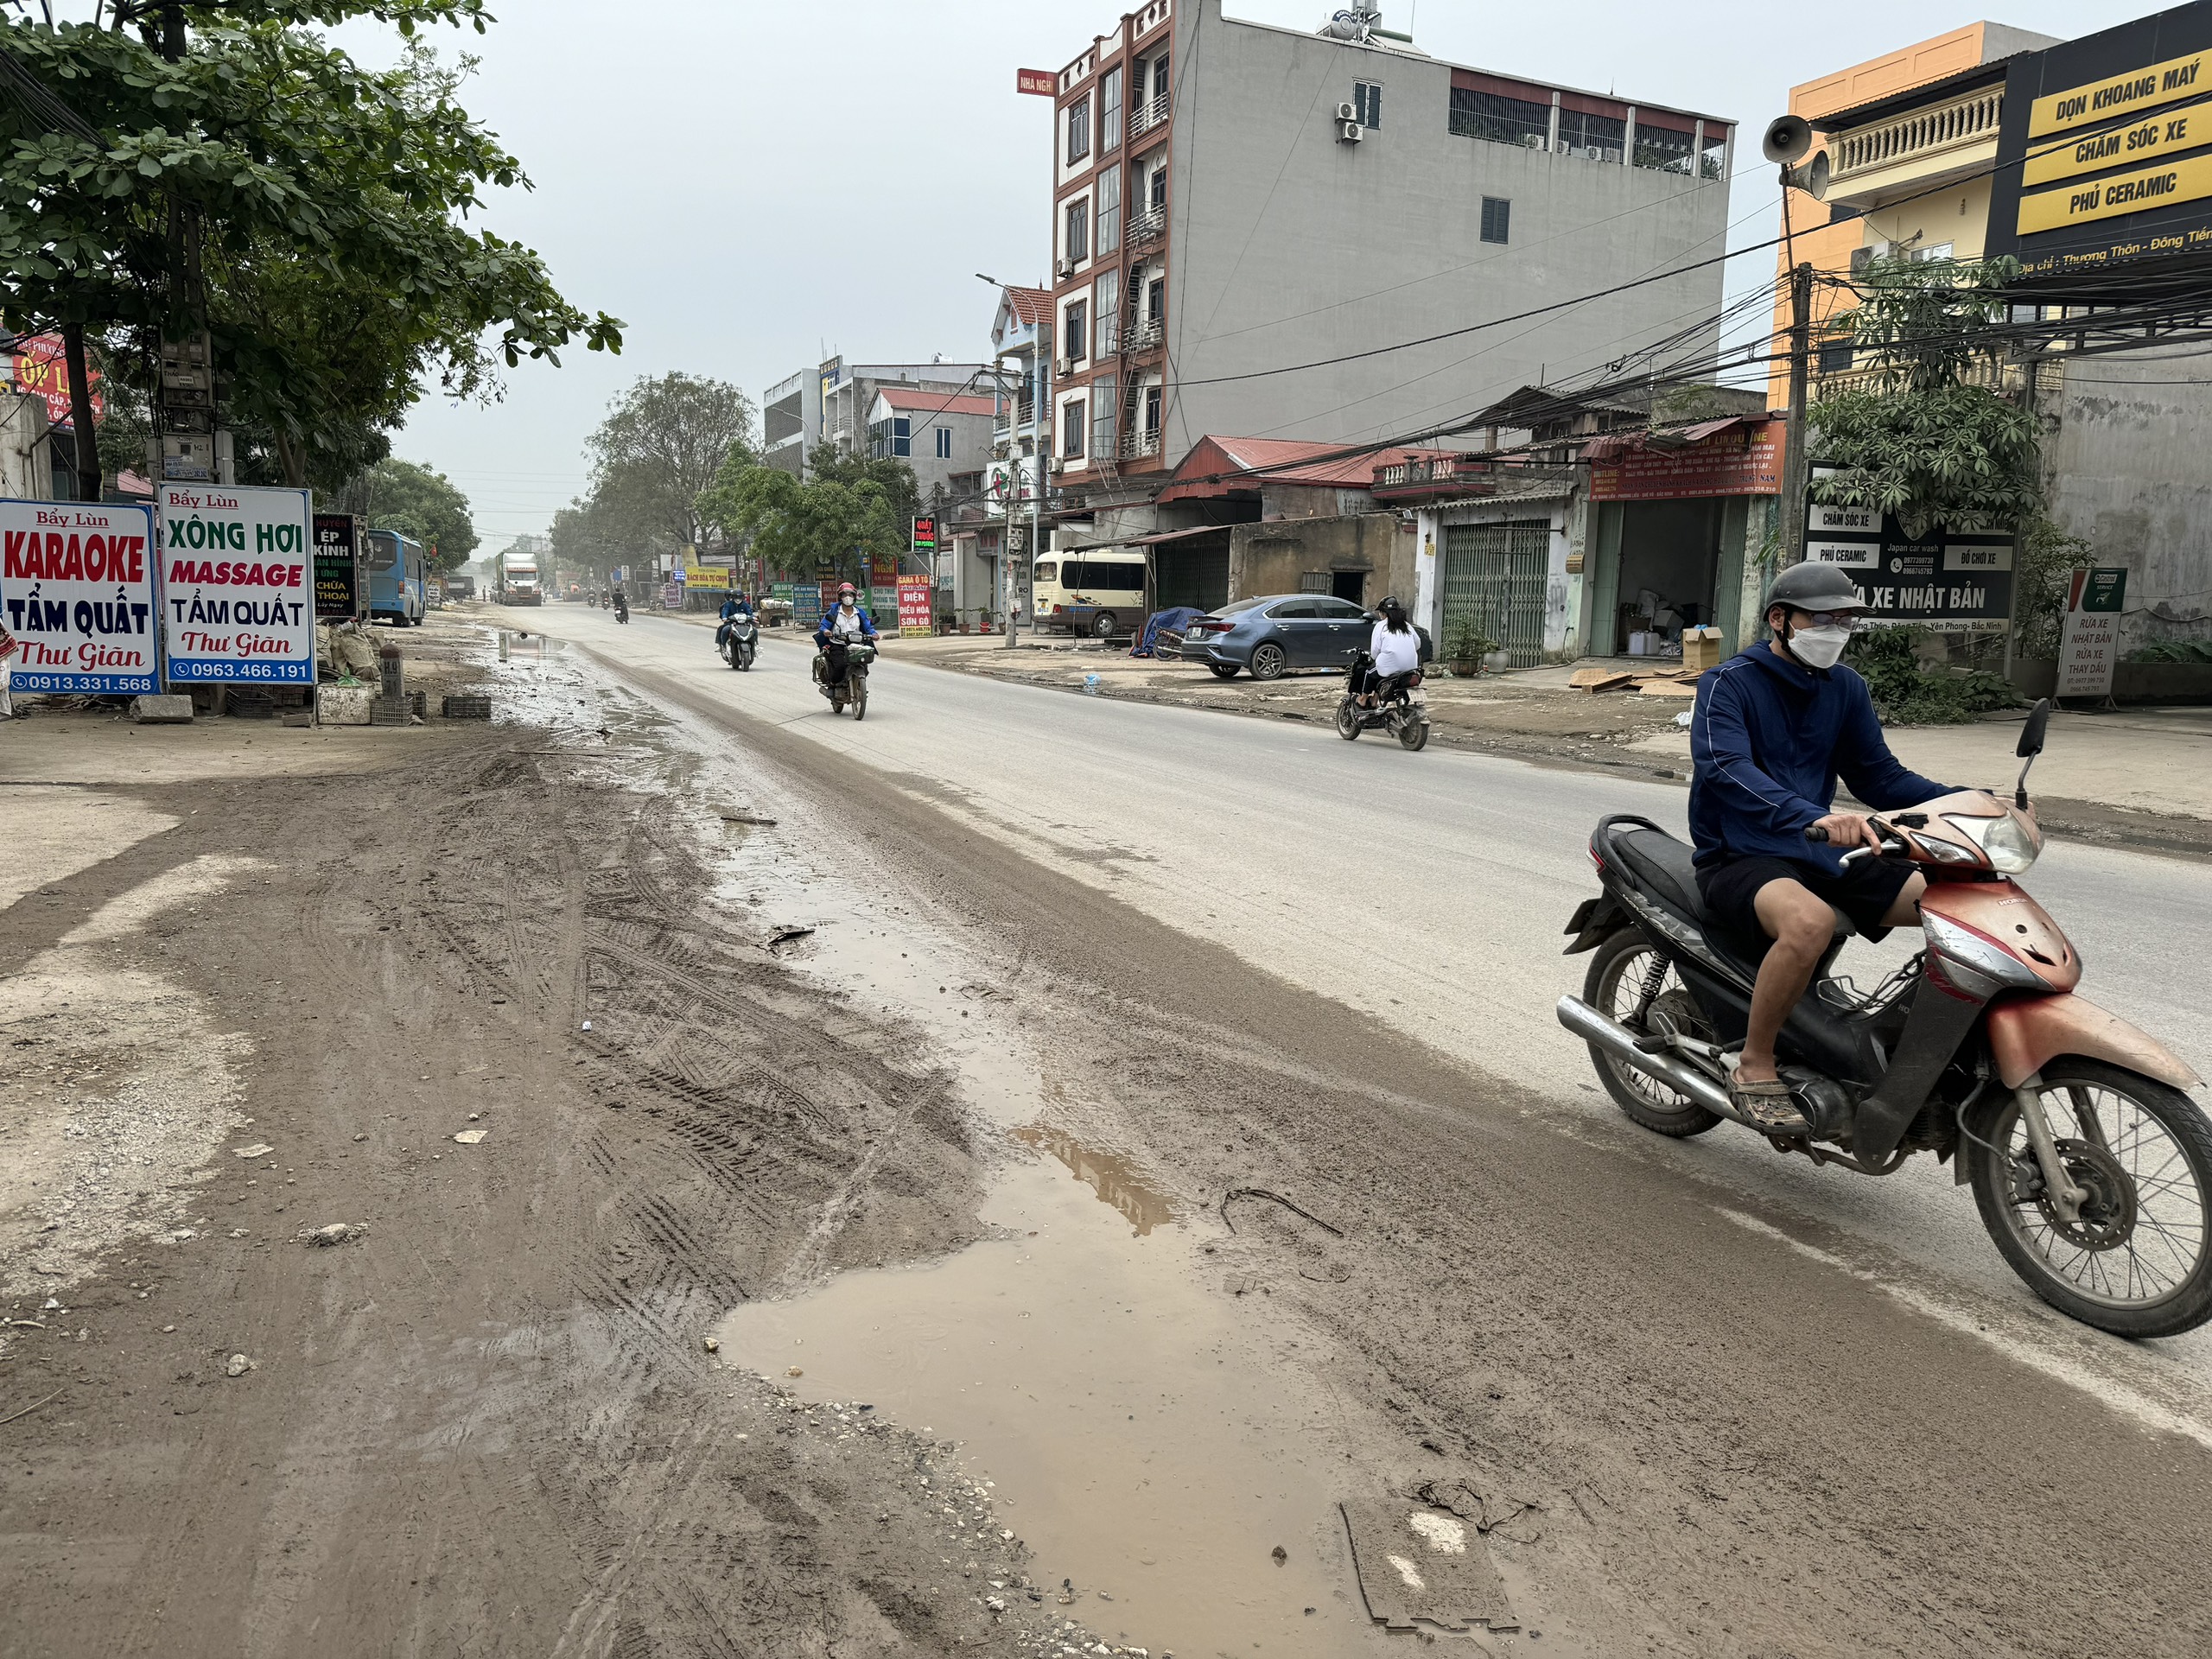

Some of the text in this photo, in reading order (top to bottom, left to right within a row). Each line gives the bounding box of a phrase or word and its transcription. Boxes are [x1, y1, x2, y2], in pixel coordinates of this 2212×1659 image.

[1020, 75, 1035, 90] NHÀ
[2056, 93, 2087, 122] DỌN
[2092, 75, 2156, 111] KHOANG
[2075, 118, 2188, 164] CHĂM SÓC XE
[2069, 173, 2177, 215] PHỦ CERAMIC
[2063, 250, 2107, 265] Thượng
[2110, 244, 2140, 257] Thôn
[2151, 237, 2183, 251] Đông
[2187, 226, 2212, 244] Tiến
[1759, 474, 1776, 483] NAM
[168, 489, 238, 509] Bẩy Lùn
[36, 508, 109, 527] Bẩy Lùn
[1823, 512, 1870, 526] CHĂM SÓC XE
[168, 513, 302, 555] XÔNG HƠI
[320, 529, 340, 543] ÉP
[313, 543, 348, 556] KÍNH
[1820, 545, 1866, 563] PHỦ CERAMIC
[1888, 543, 1908, 554] Japan
[1922, 544, 1939, 553] wash
[4, 531, 144, 582] KARAOKE
[314, 557, 328, 567] ÀN
[1972, 551, 1986, 564] CHƠI
[1987, 553, 1996, 564] XE
[168, 560, 304, 588] MASSAGE
[316, 581, 346, 590] CHỮA
[317, 592, 349, 602] THOẠI
[904, 592, 925, 603] ĐIỆN
[1872, 587, 1894, 608] XE
[1899, 583, 1945, 613] NHẬT
[1949, 581, 1986, 609] BẢN
[7, 582, 149, 639] TẨM QUẤT
[170, 588, 304, 626] TẨM QUẤT
[901, 617, 917, 626] SƠN
[1930, 621, 1943, 630] Yên
[1971, 620, 1985, 630] Bắc
[1986, 621, 2002, 630] Ninh
[2079, 616, 2108, 629] RỬA XE
[181, 631, 293, 658] Thư Giãn
[2071, 631, 2113, 646] NHẬT BẢN
[16, 641, 145, 671] Thư Giãn
[2075, 647, 2103, 659] RỬA XE
[192, 663, 306, 678] 0963.466.191
[2069, 664, 2089, 674] THAY
[29, 676, 151, 691] 0913.331.568
